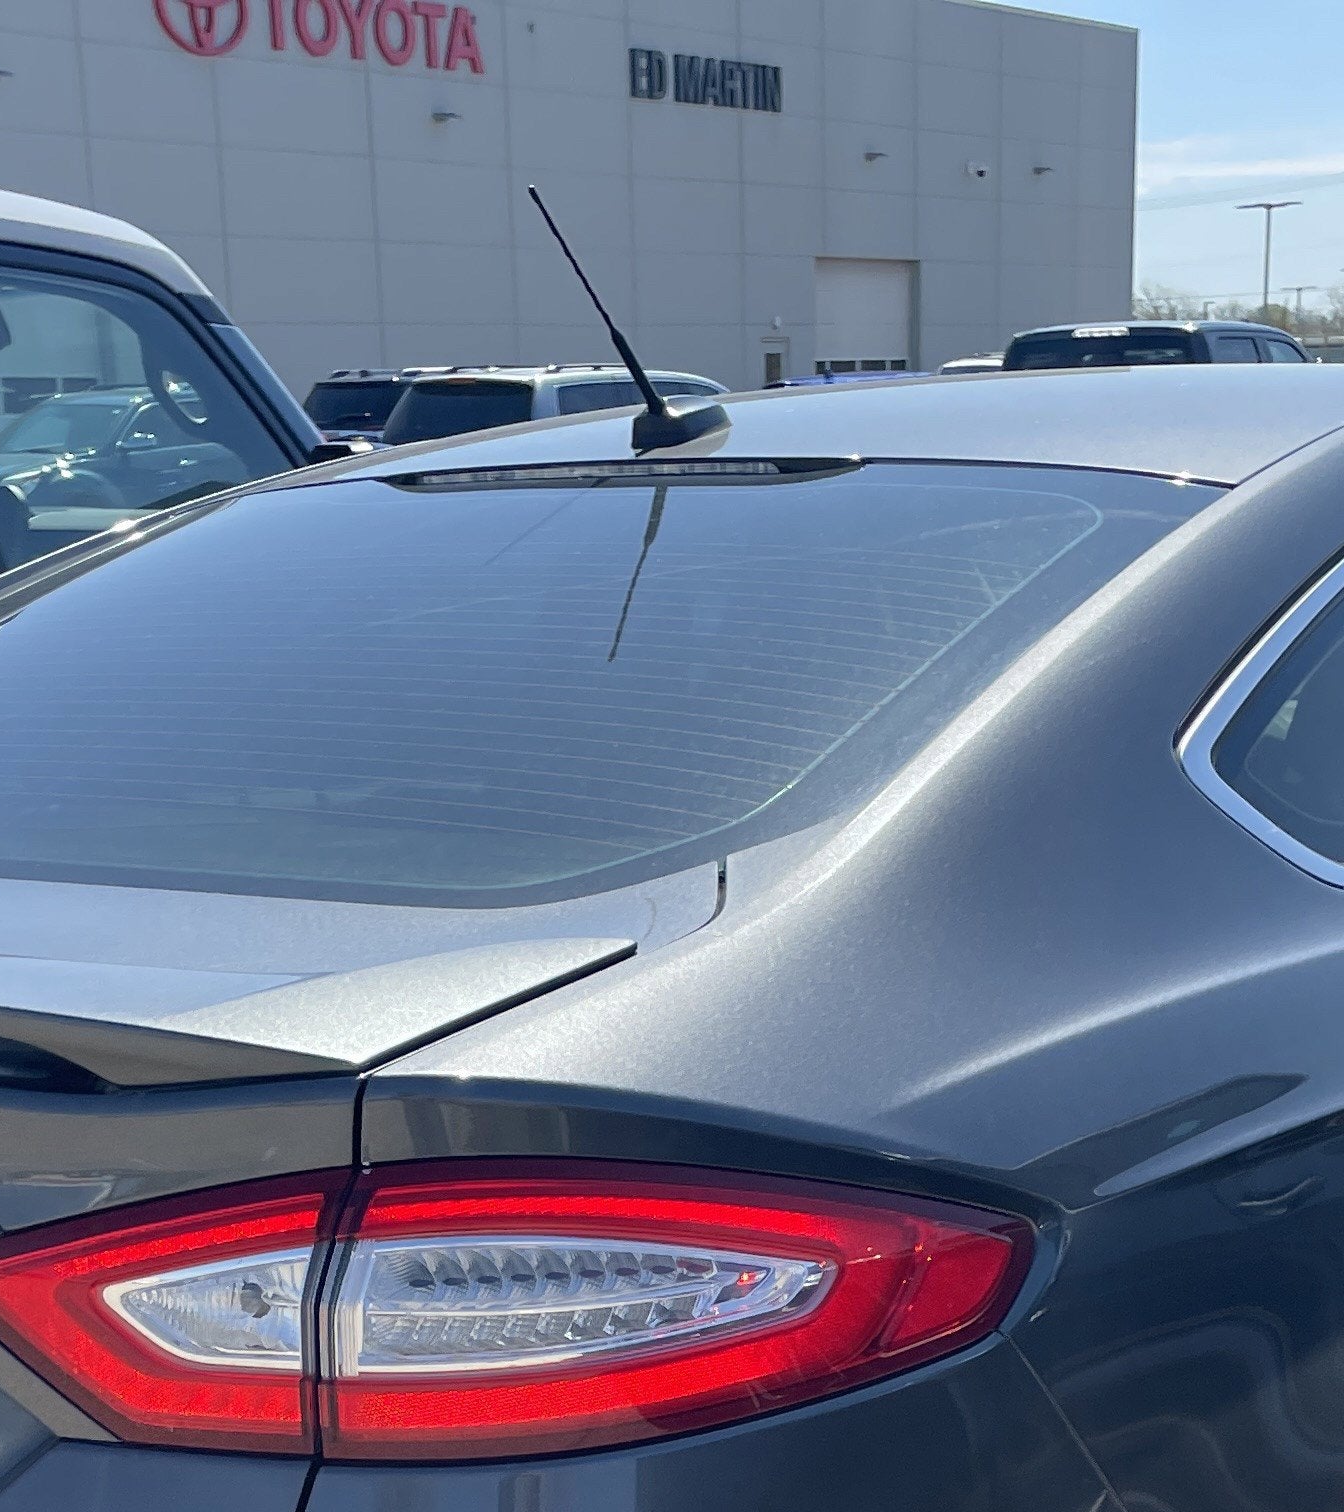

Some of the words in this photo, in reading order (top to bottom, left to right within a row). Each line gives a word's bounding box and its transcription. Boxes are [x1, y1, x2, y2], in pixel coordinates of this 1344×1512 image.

[268, 0, 485, 74] TOYOTA
[628, 48, 667, 99] ED
[673, 54, 782, 113] MARTIN
